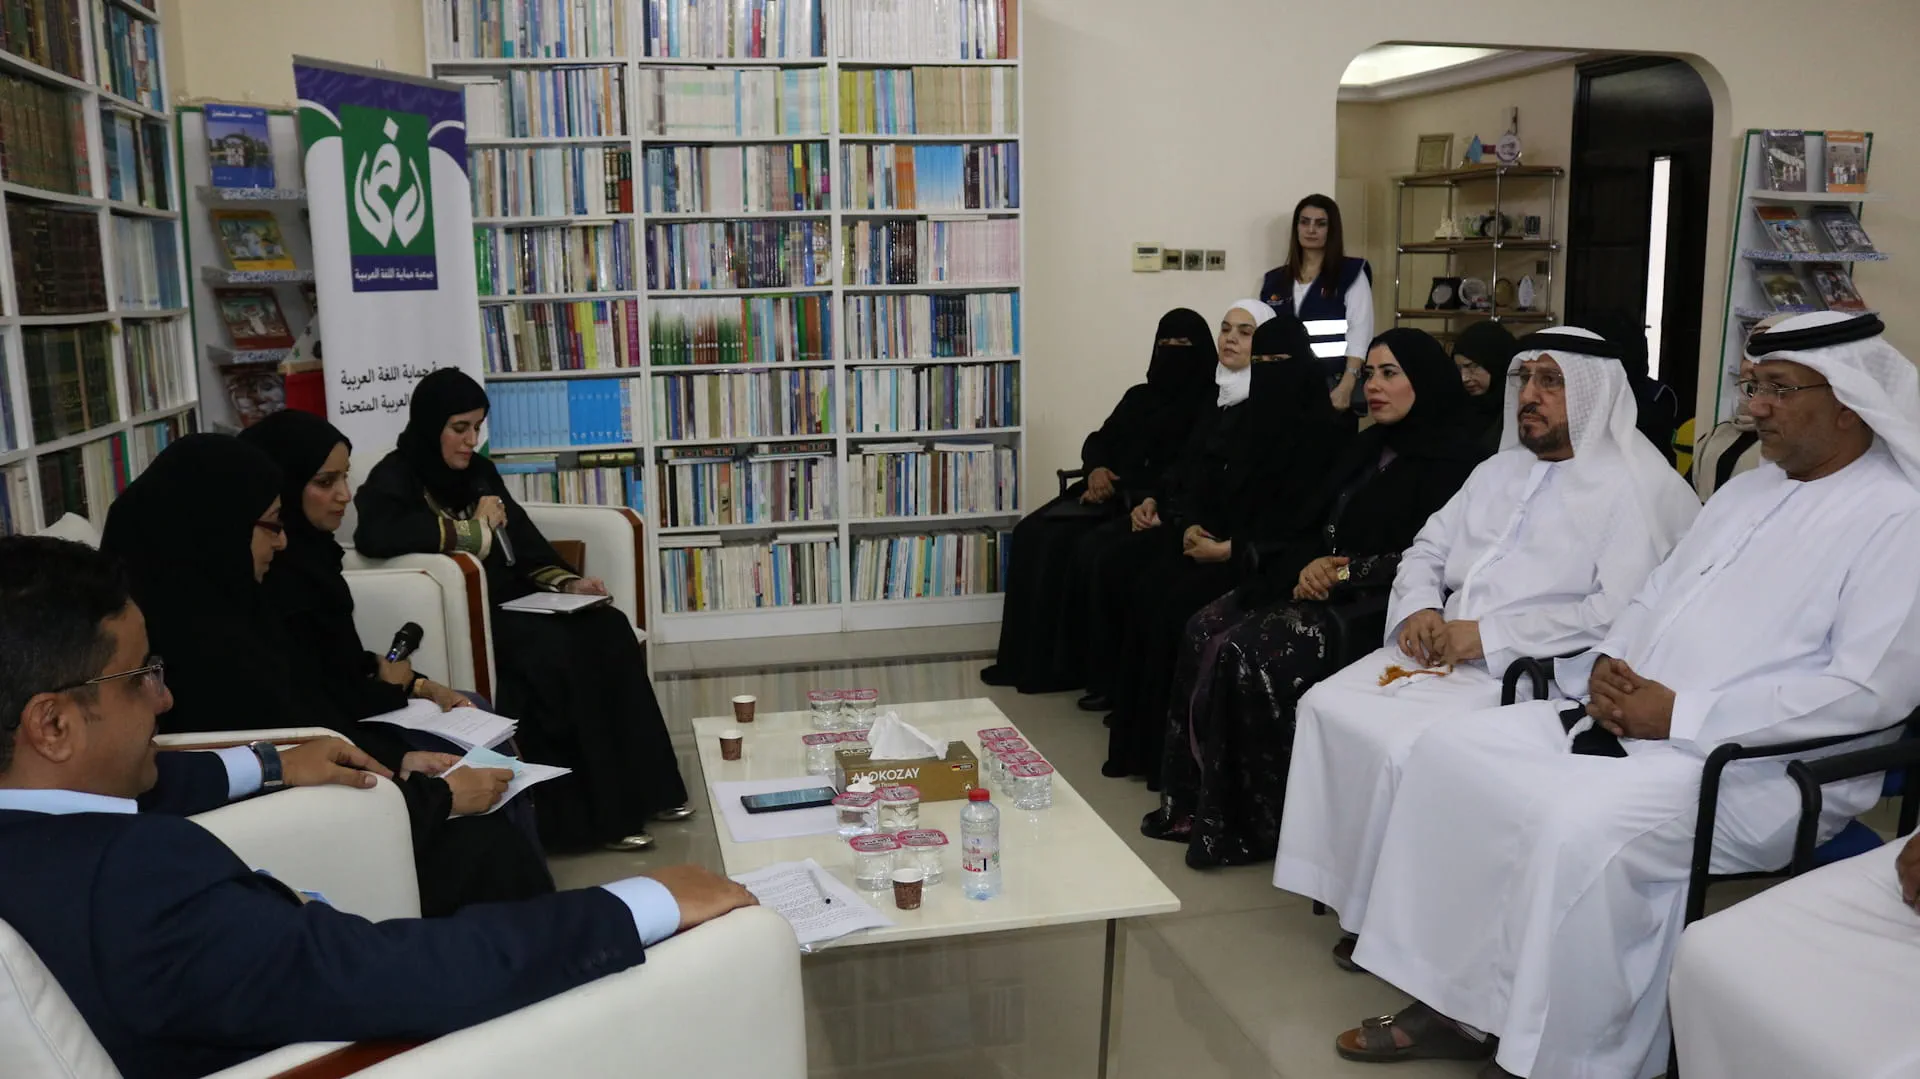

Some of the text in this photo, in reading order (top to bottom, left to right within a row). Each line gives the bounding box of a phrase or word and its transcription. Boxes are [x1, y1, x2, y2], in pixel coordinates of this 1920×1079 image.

[354, 266, 434, 282] جمعية حماية اللغة العربية
[341, 369, 375, 390] العربية
[378, 366, 400, 381] اللغة
[340, 393, 410, 415] العربية المتحدة
